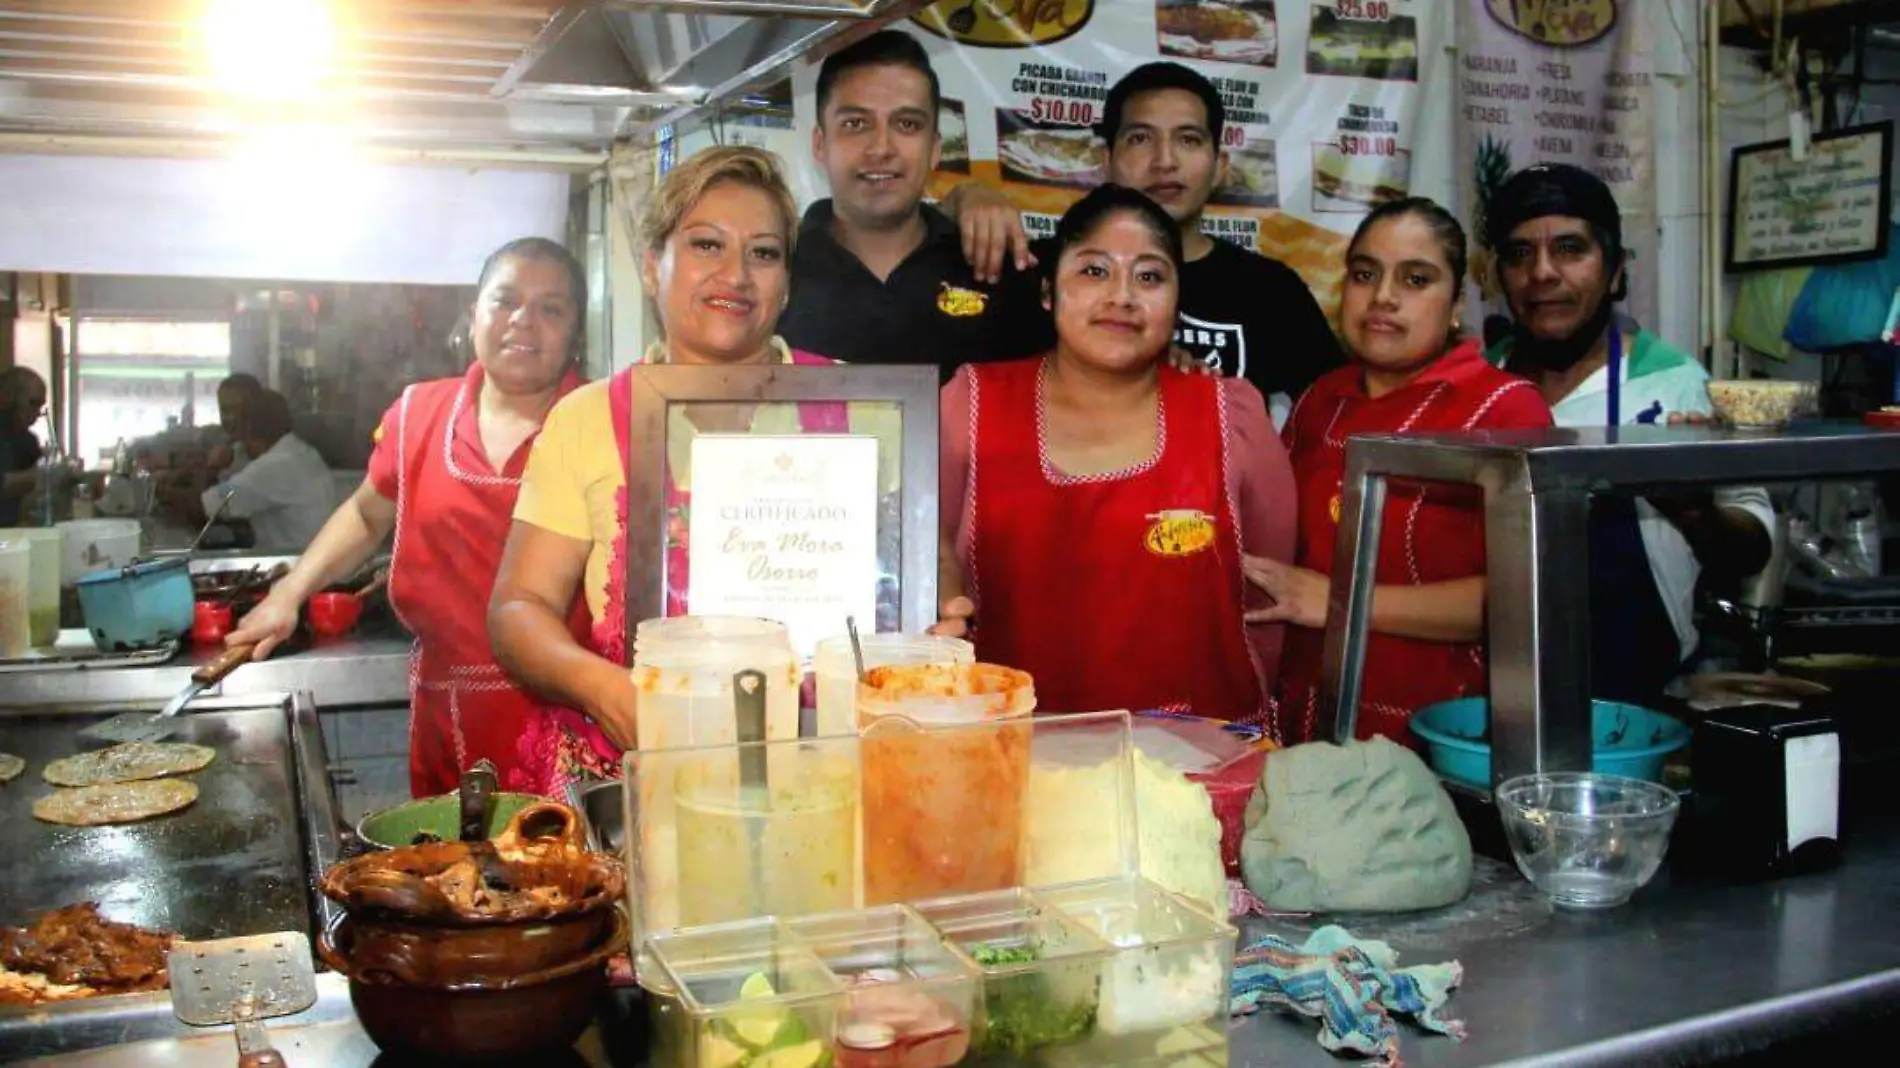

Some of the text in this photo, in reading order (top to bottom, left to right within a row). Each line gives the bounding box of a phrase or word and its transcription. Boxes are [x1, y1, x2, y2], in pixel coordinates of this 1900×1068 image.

[1019, 62, 1062, 79] PICADA
[1012, 78, 1106, 101] CON CHICHARRO
[1031, 97, 1092, 124] $10.00
[1339, 135, 1396, 156] $30.00
[720, 505, 847, 521] CERTIFICADO
[721, 525, 844, 554] Eva Mora
